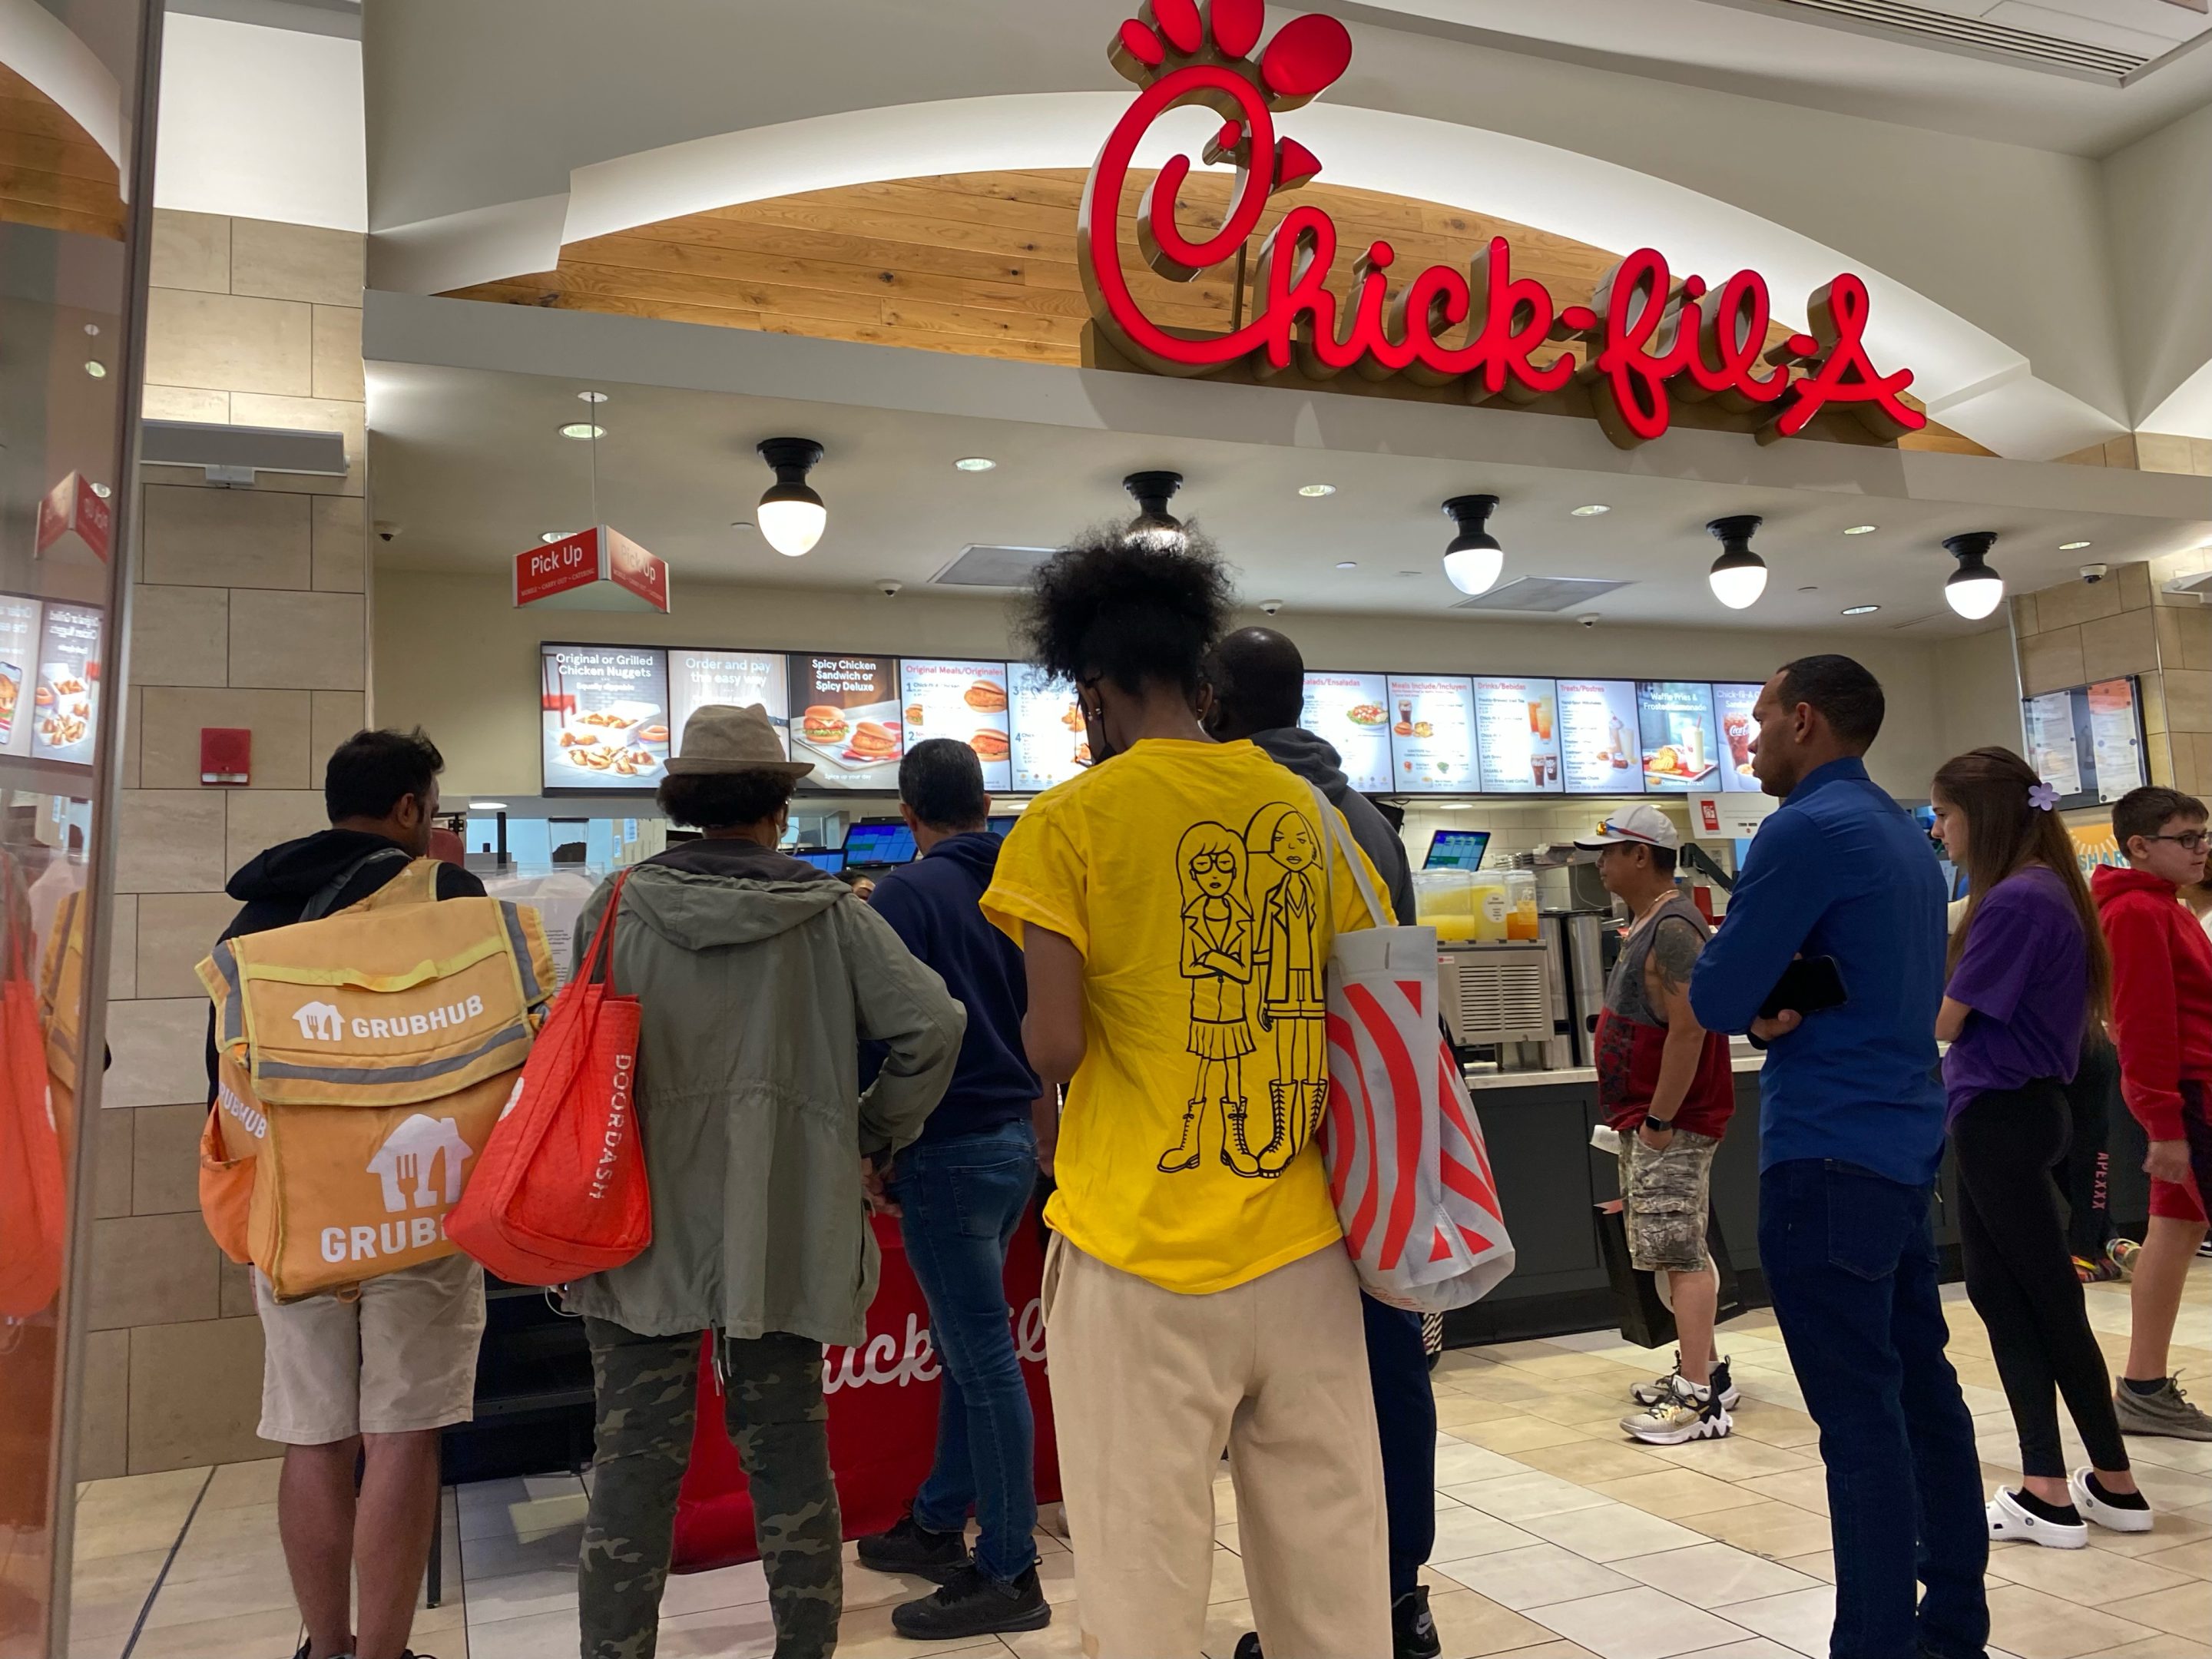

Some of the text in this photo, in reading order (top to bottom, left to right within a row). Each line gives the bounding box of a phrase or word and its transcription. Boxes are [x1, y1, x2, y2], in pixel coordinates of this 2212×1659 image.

[1089, 63, 1927, 440] Chick-fil-A
[531, 545, 582, 576] Pick Up
[643, 560, 656, 584] Up
[556, 653, 653, 666] Original or Grilled
[685, 657, 771, 674] Order and pay
[812, 659, 876, 671] Spicy Chicken
[558, 665, 651, 679] Chicken Nuggets
[816, 671, 861, 680] Sandwich
[906, 665, 1004, 677] Original Meals/Originales
[690, 671, 767, 687] the easy way
[816, 680, 874, 693] Spicy Deluxe
[906, 683, 912, 692] 1
[1013, 686, 1018, 695] 3
[1412, 682, 1467, 691] Include/Incluyen
[1651, 693, 1671, 701] Waffle
[1674, 693, 1691, 701] Fries
[908, 731, 915, 741] 2
[1015, 733, 1022, 742] 4
[351, 995, 484, 1038] GRUBHUB
[218, 1081, 267, 1139] RUBHUB
[589, 1055, 631, 1200] DOORDASH
[2091, 1152, 2110, 1210] APEXXX
[321, 1213, 449, 1263] GRUB
